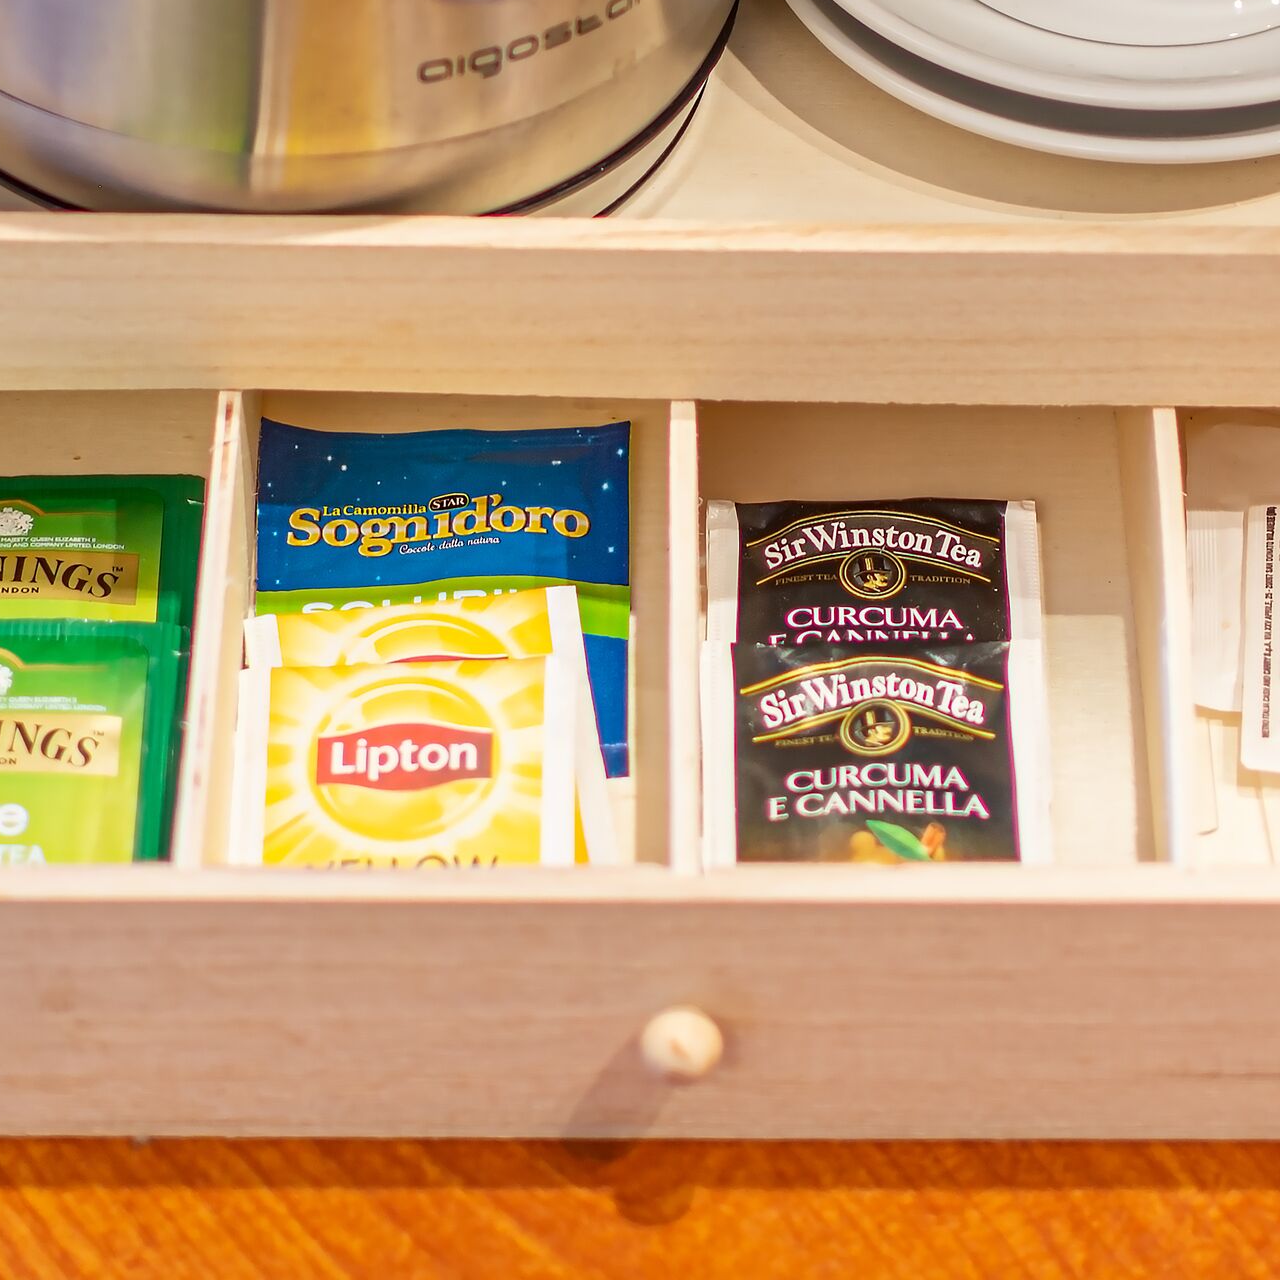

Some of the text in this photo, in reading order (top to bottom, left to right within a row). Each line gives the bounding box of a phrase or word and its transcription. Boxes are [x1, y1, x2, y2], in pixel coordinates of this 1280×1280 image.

[322, 496, 466, 517] La Camomilla STAR
[398, 535, 500, 555] Coccole dalla natura
[816, 573, 838, 581] TEA
[909, 574, 971, 585] TRADITION
[787, 606, 964, 630] CURCUMA
[329, 738, 478, 781] Lipton
[785, 761, 970, 792] CURCUMA
[768, 789, 990, 821] E CANNELLA
